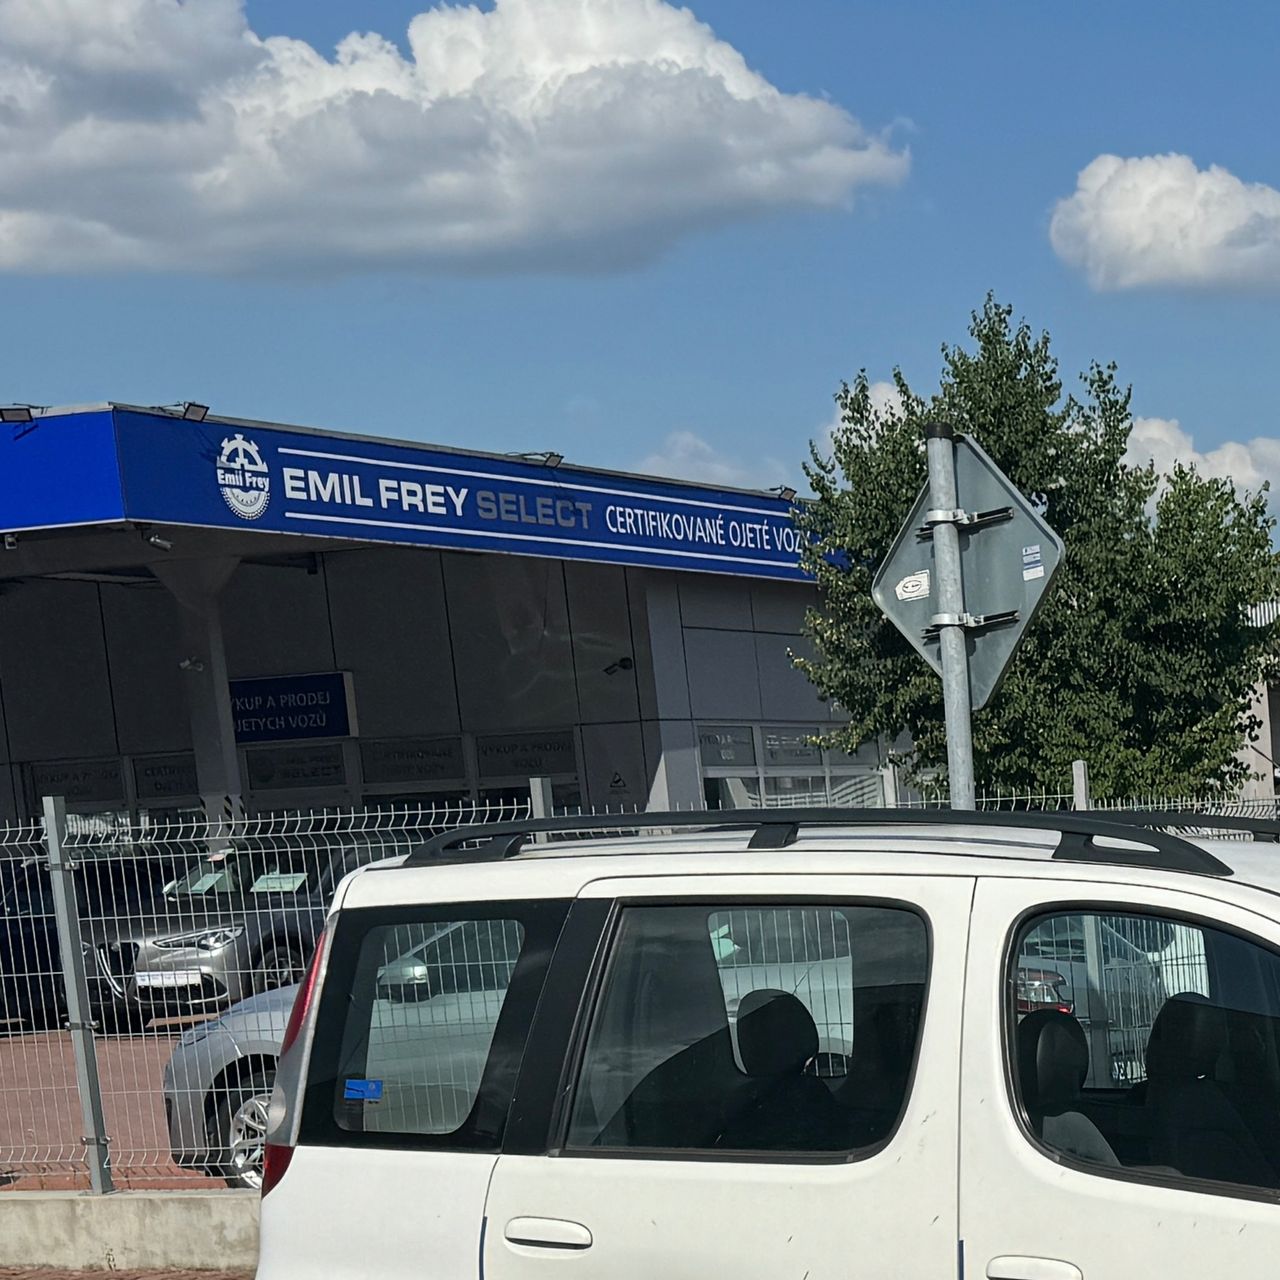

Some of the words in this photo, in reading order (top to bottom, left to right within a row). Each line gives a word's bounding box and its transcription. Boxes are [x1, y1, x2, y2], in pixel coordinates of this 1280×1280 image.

[216, 469, 243, 486] Emil
[244, 472, 270, 492] Frey
[283, 467, 374, 508] EMIL
[378, 478, 468, 517] FREY
[476, 490, 592, 529] SELECT
[605, 505, 726, 546] CERTIFIKOVANÉ
[729, 519, 771, 550] OJETÉ
[266, 695, 277, 709] A
[279, 691, 331, 707] PRODEJ
[236, 714, 286, 732] JETÝCH
